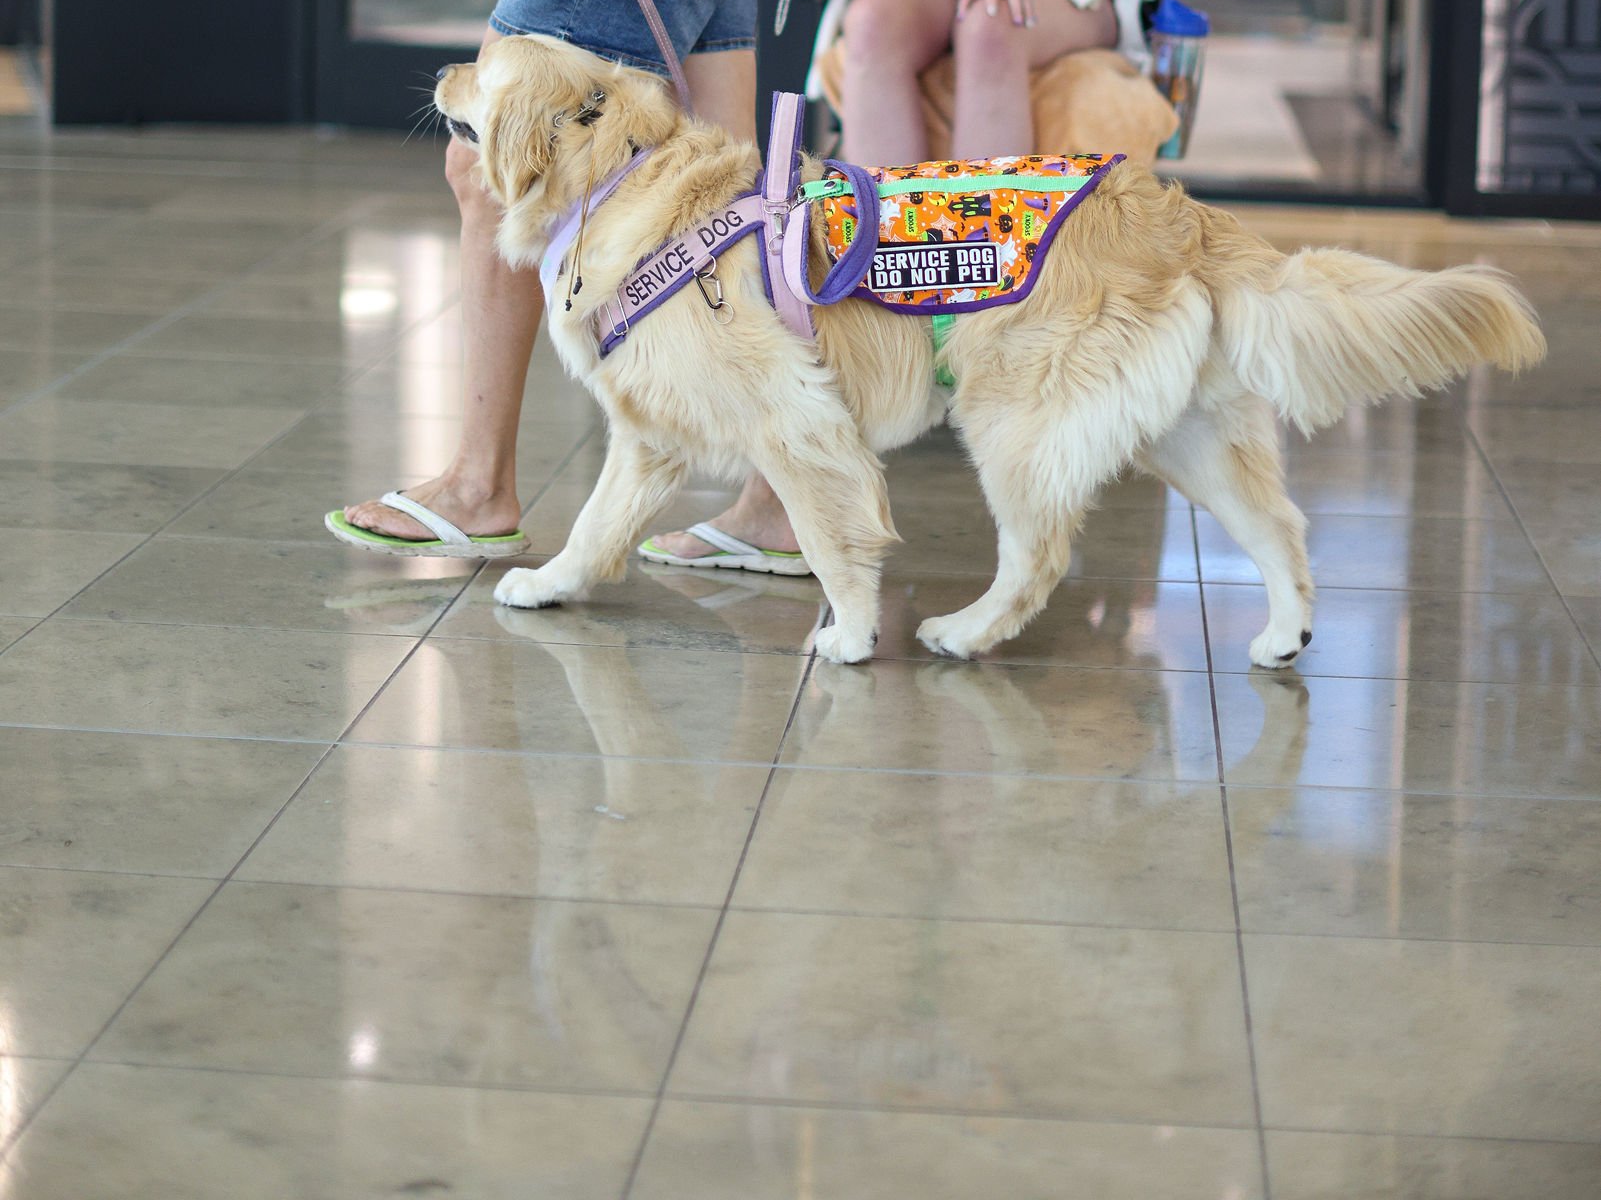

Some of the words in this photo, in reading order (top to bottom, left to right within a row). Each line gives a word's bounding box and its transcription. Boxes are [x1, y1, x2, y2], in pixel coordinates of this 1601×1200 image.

[625, 242, 694, 306] SERVICE
[697, 210, 744, 248] DOG
[873, 250, 950, 270] SERVICE
[956, 247, 994, 266] DOG
[875, 269, 902, 287] DO
[911, 266, 950, 285] NOT
[958, 264, 994, 282] PET
